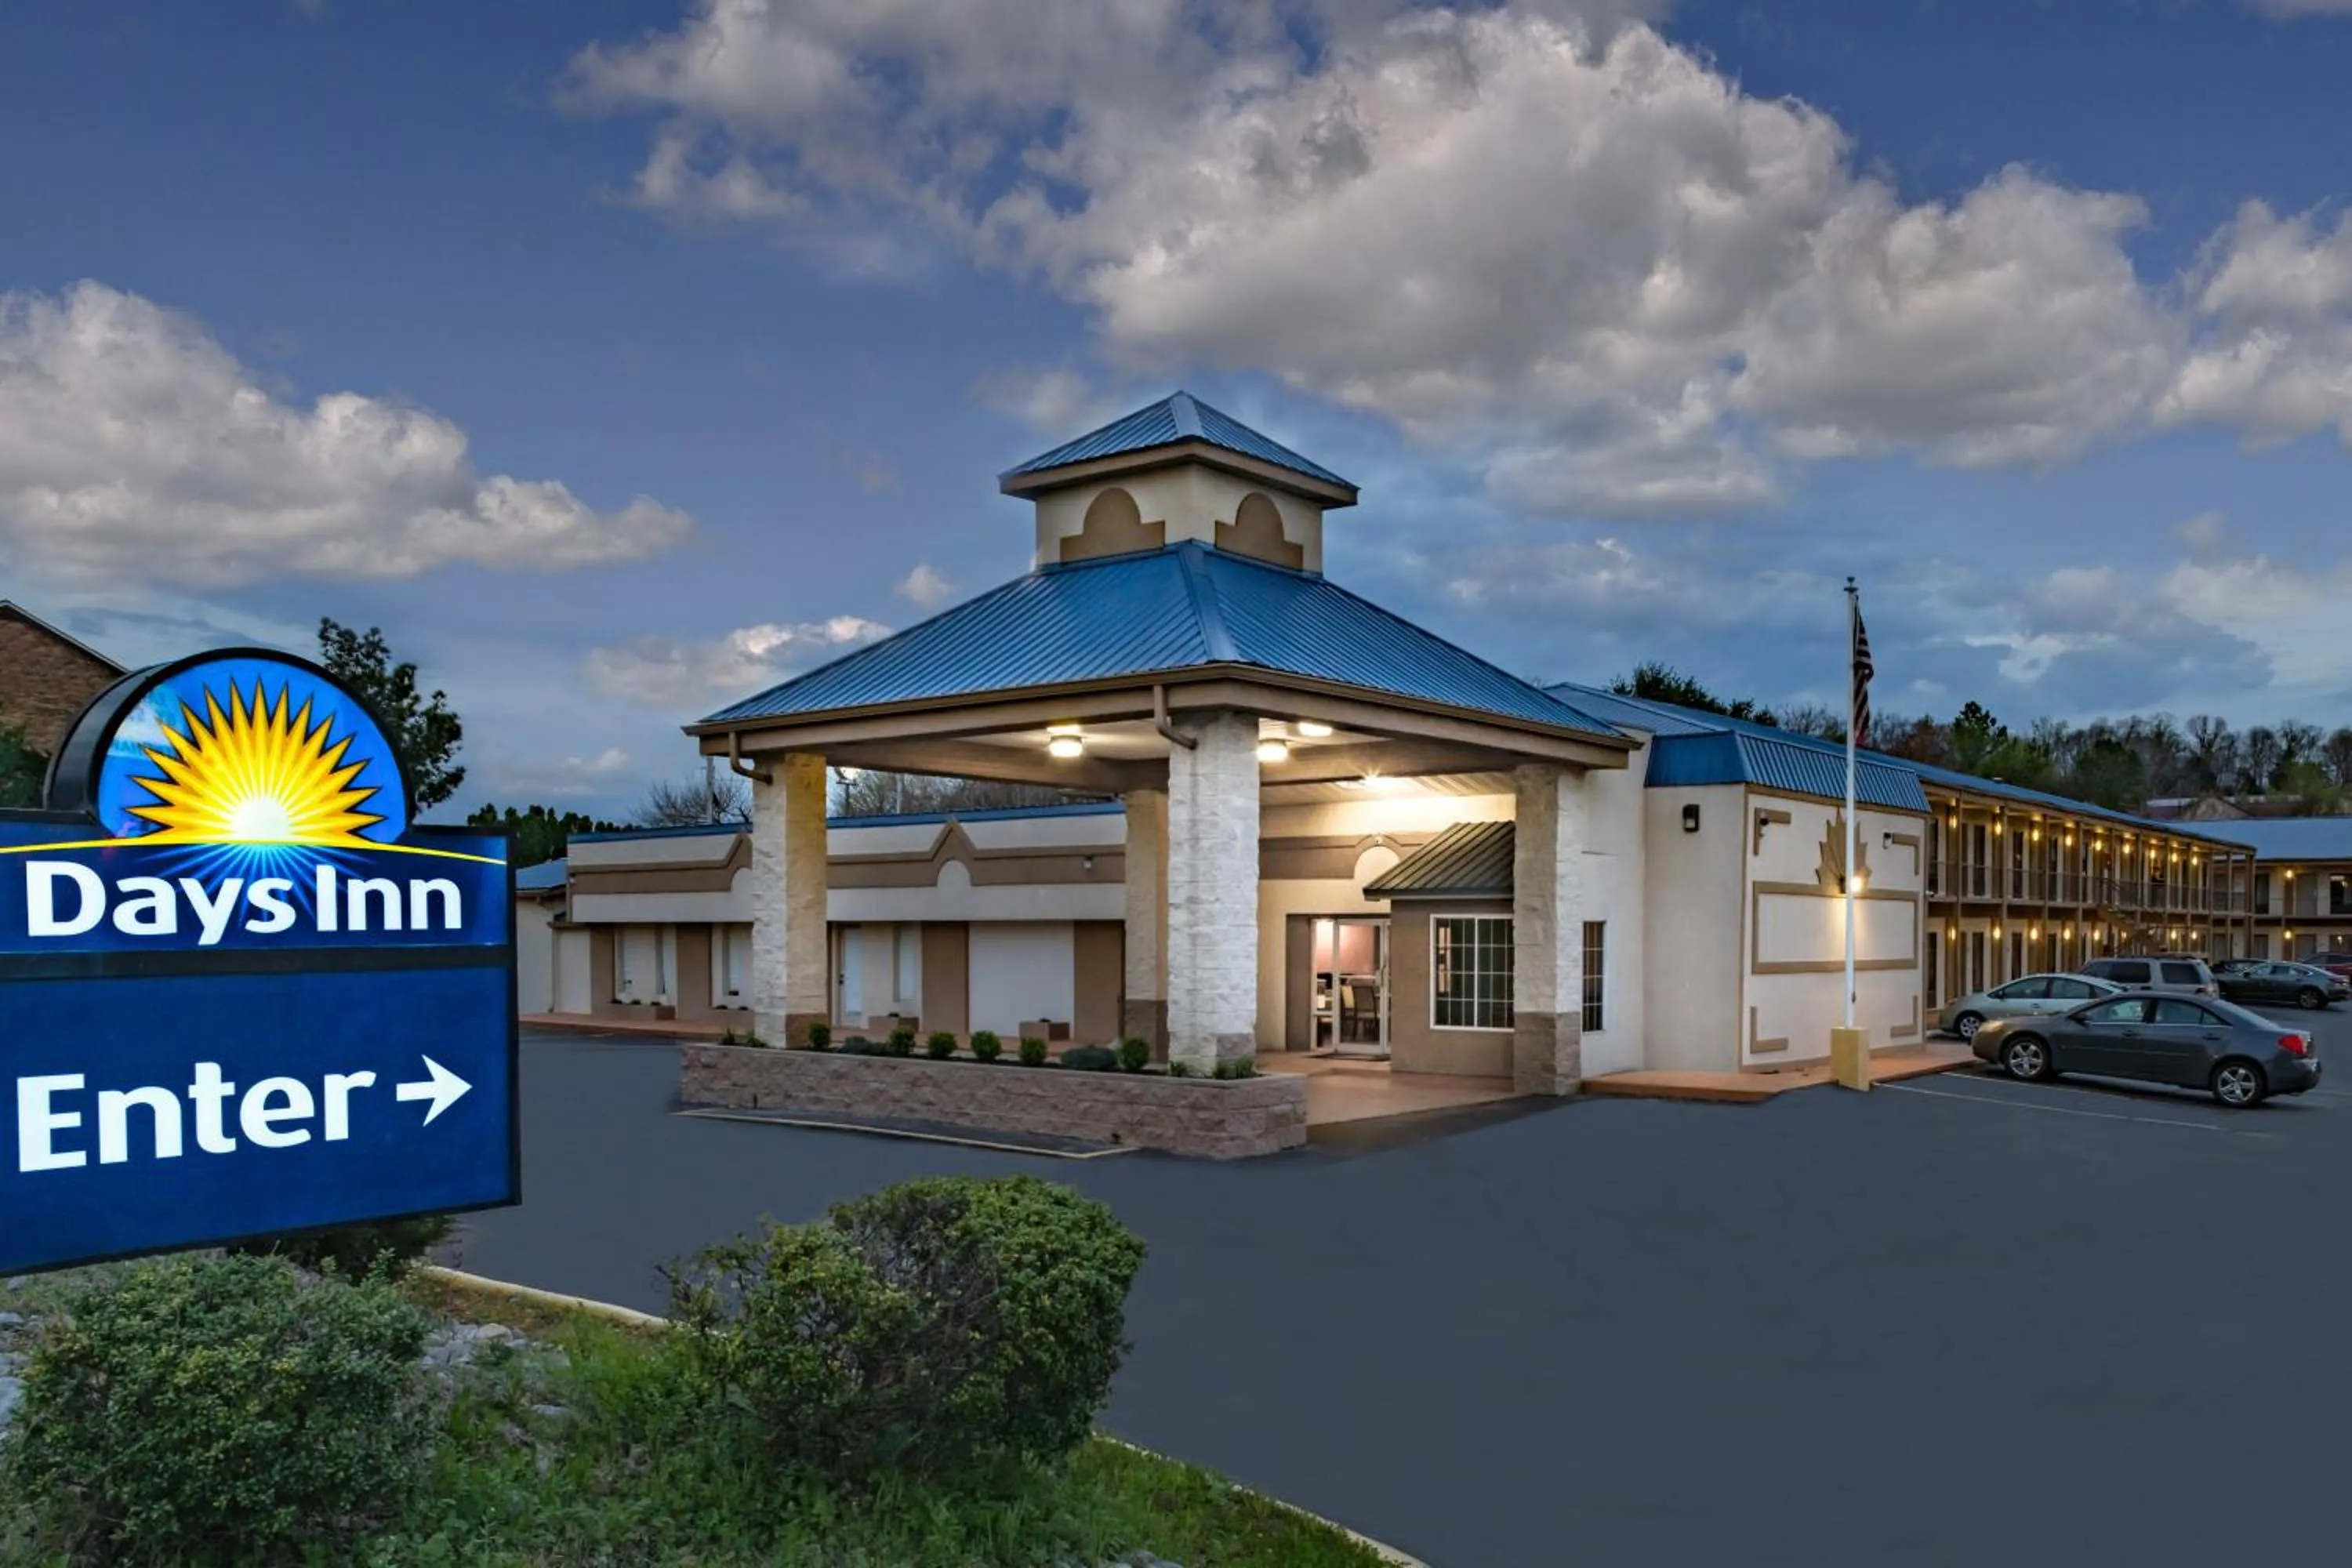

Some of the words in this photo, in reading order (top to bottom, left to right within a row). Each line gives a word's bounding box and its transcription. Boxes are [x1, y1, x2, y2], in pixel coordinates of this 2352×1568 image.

[26, 860, 296, 946] Days
[316, 865, 462, 931] Inn
[16, 1062, 377, 1172] Enter
